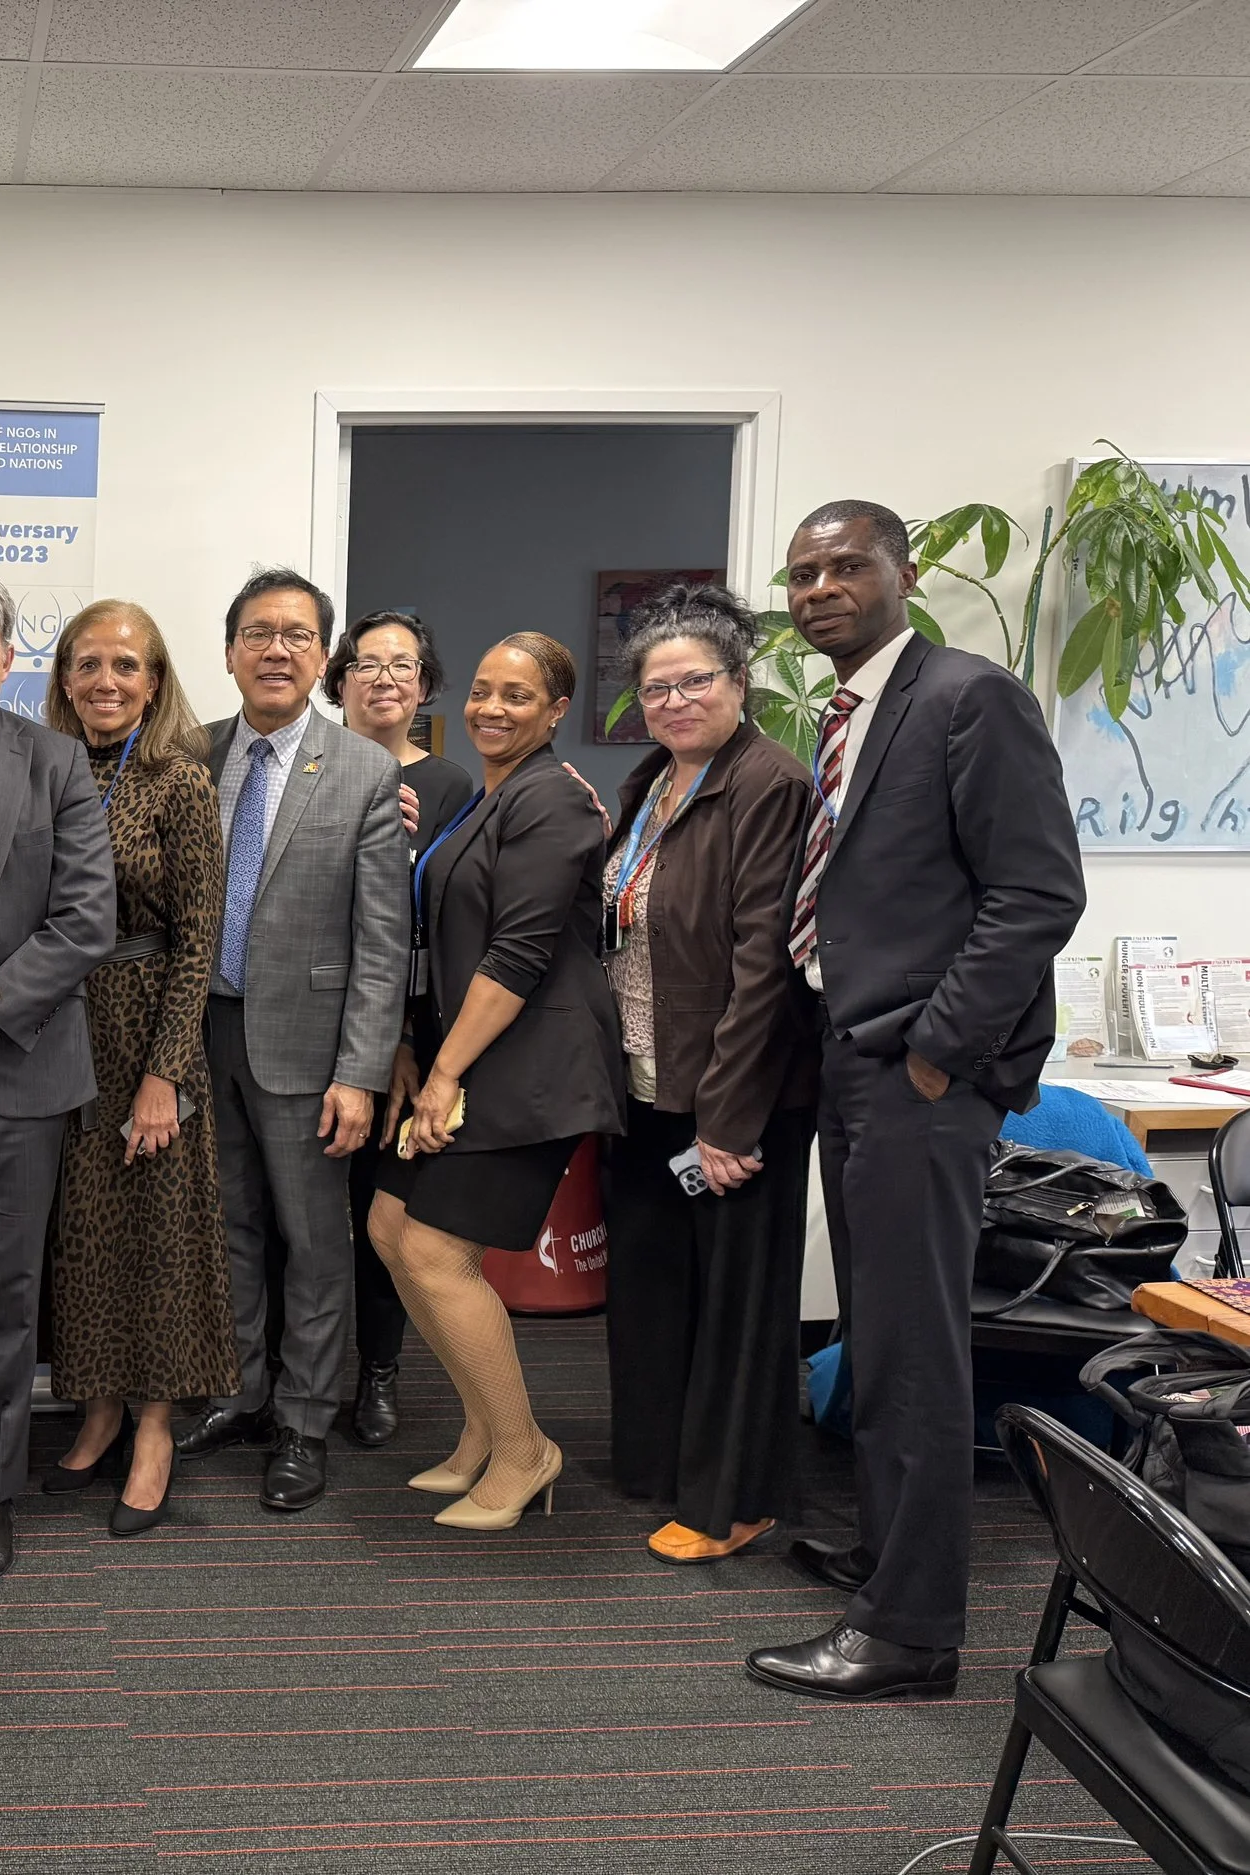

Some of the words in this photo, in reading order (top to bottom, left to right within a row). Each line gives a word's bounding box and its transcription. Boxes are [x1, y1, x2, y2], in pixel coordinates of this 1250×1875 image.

[6, 427, 41, 439] NGOs
[44, 428, 57, 439] IN
[9, 458, 63, 470] NATIONS
